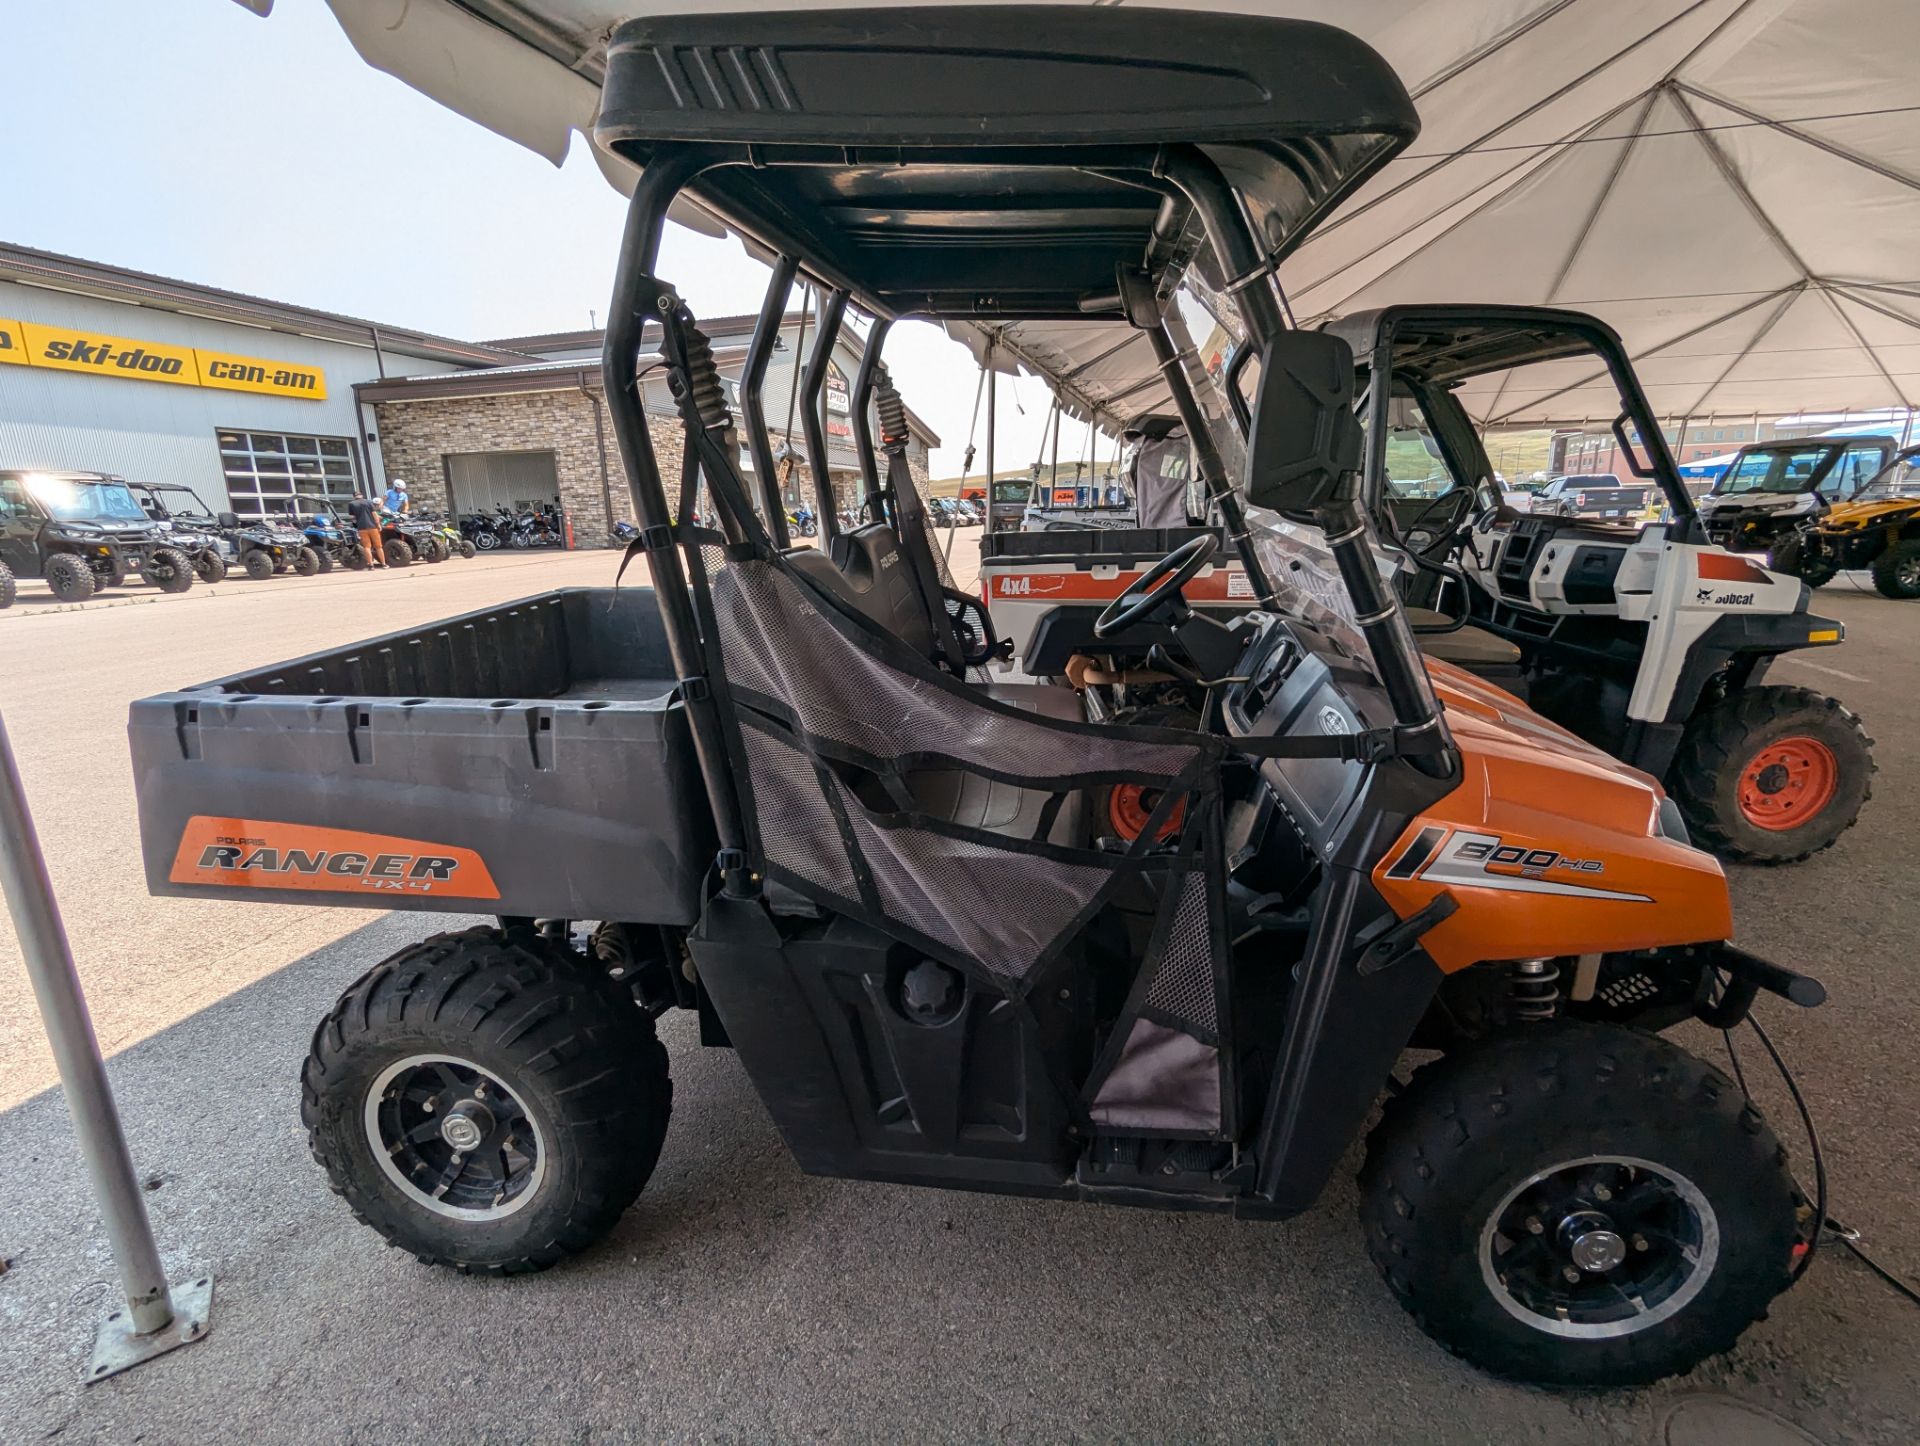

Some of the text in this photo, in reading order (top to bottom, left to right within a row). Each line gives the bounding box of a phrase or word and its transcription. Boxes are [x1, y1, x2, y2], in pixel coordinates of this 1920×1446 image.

[44, 340, 184, 376] ski-doo
[208, 360, 317, 390] can-am
[829, 391, 846, 404] PID
[1000, 576, 1030, 595] 4x4
[216, 836, 266, 846] POLARIS
[1453, 841, 1560, 869] 800
[197, 845, 460, 881] RANGER
